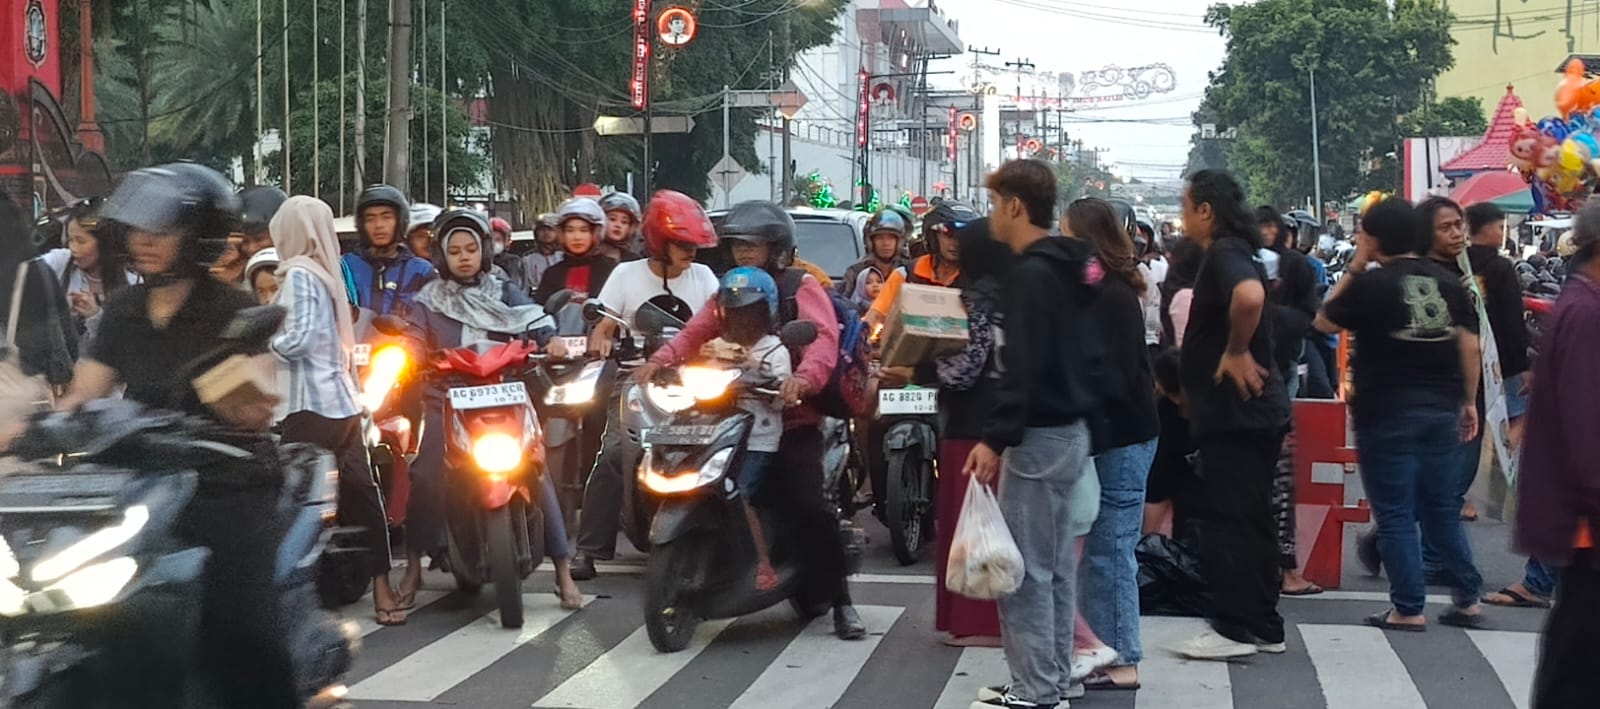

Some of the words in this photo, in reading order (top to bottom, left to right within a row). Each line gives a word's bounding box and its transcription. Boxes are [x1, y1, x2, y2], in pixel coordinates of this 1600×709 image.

[453, 389, 467, 398] AG
[470, 386, 498, 397] 6973
[501, 383, 524, 394] KCR
[882, 392, 895, 402] AG
